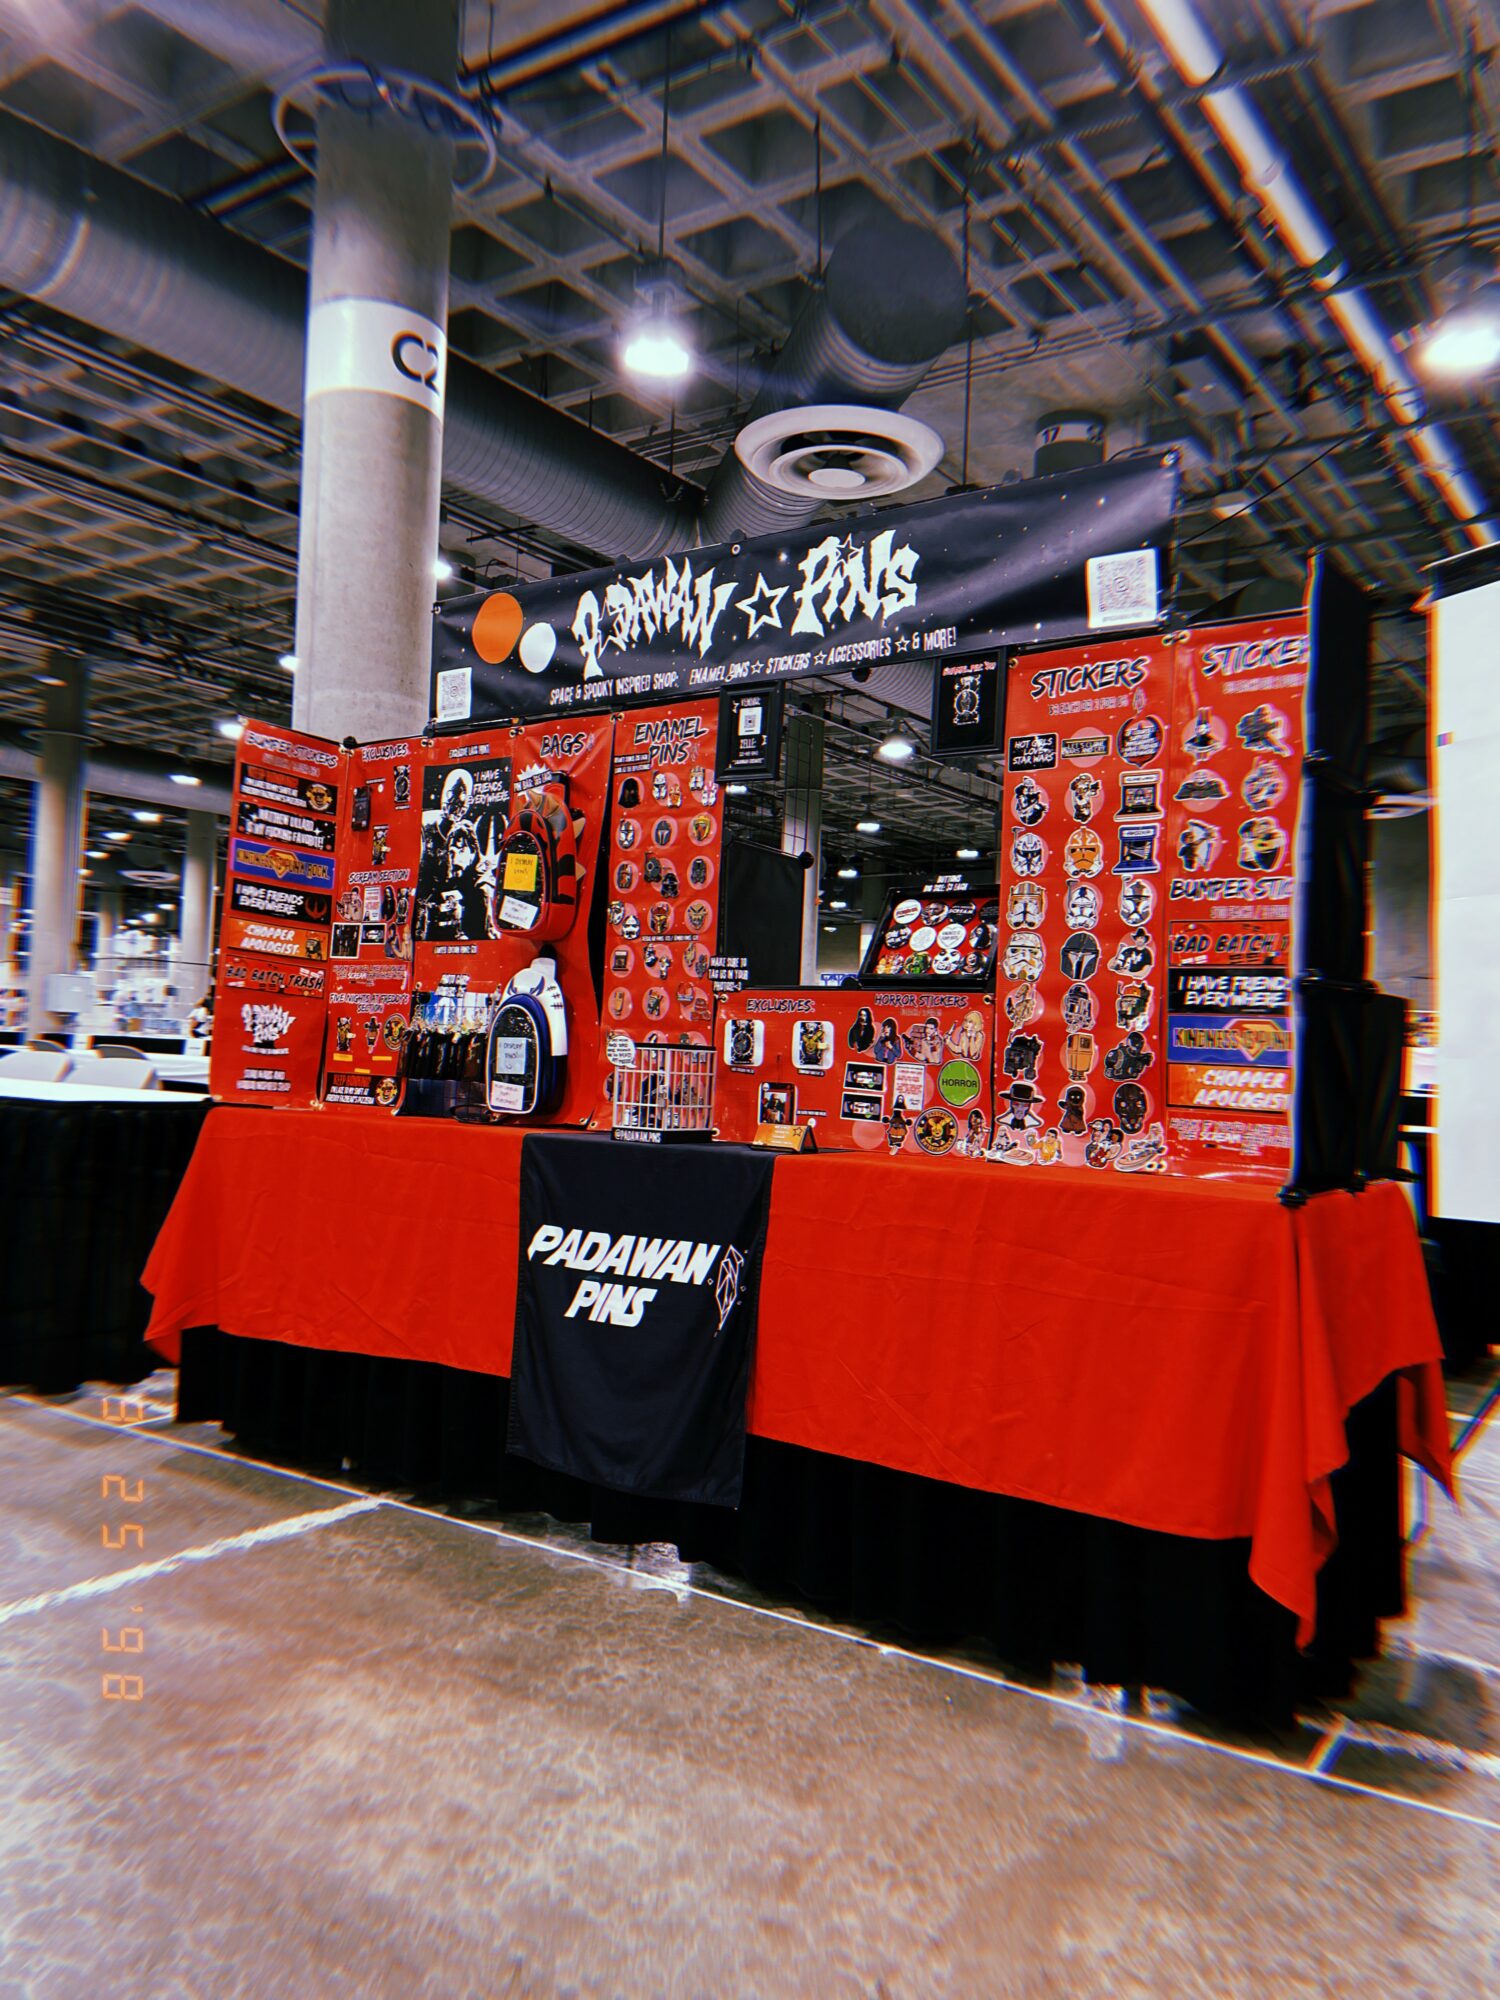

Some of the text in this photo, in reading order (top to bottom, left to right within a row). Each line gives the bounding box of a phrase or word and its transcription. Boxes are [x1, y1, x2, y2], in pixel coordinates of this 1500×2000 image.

[391, 331, 440, 396] C2
[550, 686, 574, 706] SPACE
[583, 679, 613, 703] SPOOKY
[616, 674, 651, 696] INSPIRED
[689, 665, 725, 686] ENAMEL
[727, 662, 751, 683] PINS
[766, 652, 811, 675] STICKERS
[827, 637, 892, 666] ACCESSORIES
[911, 632, 920, 650] &
[924, 625, 957, 652] MORE!
[1030, 656, 1152, 700] STICKERS
[633, 717, 709, 745] ENAMEL
[362, 743, 409, 762] EXCLUSIVES
[540, 732, 588, 759] BAGS
[649, 740, 691, 766] PINS
[1015, 740, 1030, 749] HOT
[288, 744, 338, 768] STICKERS
[1012, 754, 1054, 765] STAR WARS
[481, 769, 499, 781] HAVE
[473, 781, 502, 795] FRIENDS
[349, 869, 410, 885] SCREAM SECTION
[241, 885, 266, 898] HAVE
[266, 889, 304, 905] FRIENDS
[1169, 877, 1254, 902] BUMPER
[1173, 934, 1276, 953] BAD BATCH
[710, 957, 748, 967] MAKE SURE TO
[225, 966, 324, 990] BAD BATCH TRASH
[708, 969, 719, 979] TAG
[735, 969, 748, 980] YOUR
[1186, 975, 1230, 991] HAVE
[329, 992, 410, 1005] FIVE NIGHTS AT FREDDY'S
[874, 993, 968, 1009] HORROR STICKERS
[357, 1004, 384, 1014] SECTION
[1173, 1027, 1241, 1050] KINDNESS
[942, 1078, 978, 1089] HORROR
[1200, 1131, 1241, 1143] SCREAM
[527, 1224, 721, 1285] PADAWAN
[563, 1279, 658, 1328] PINS
